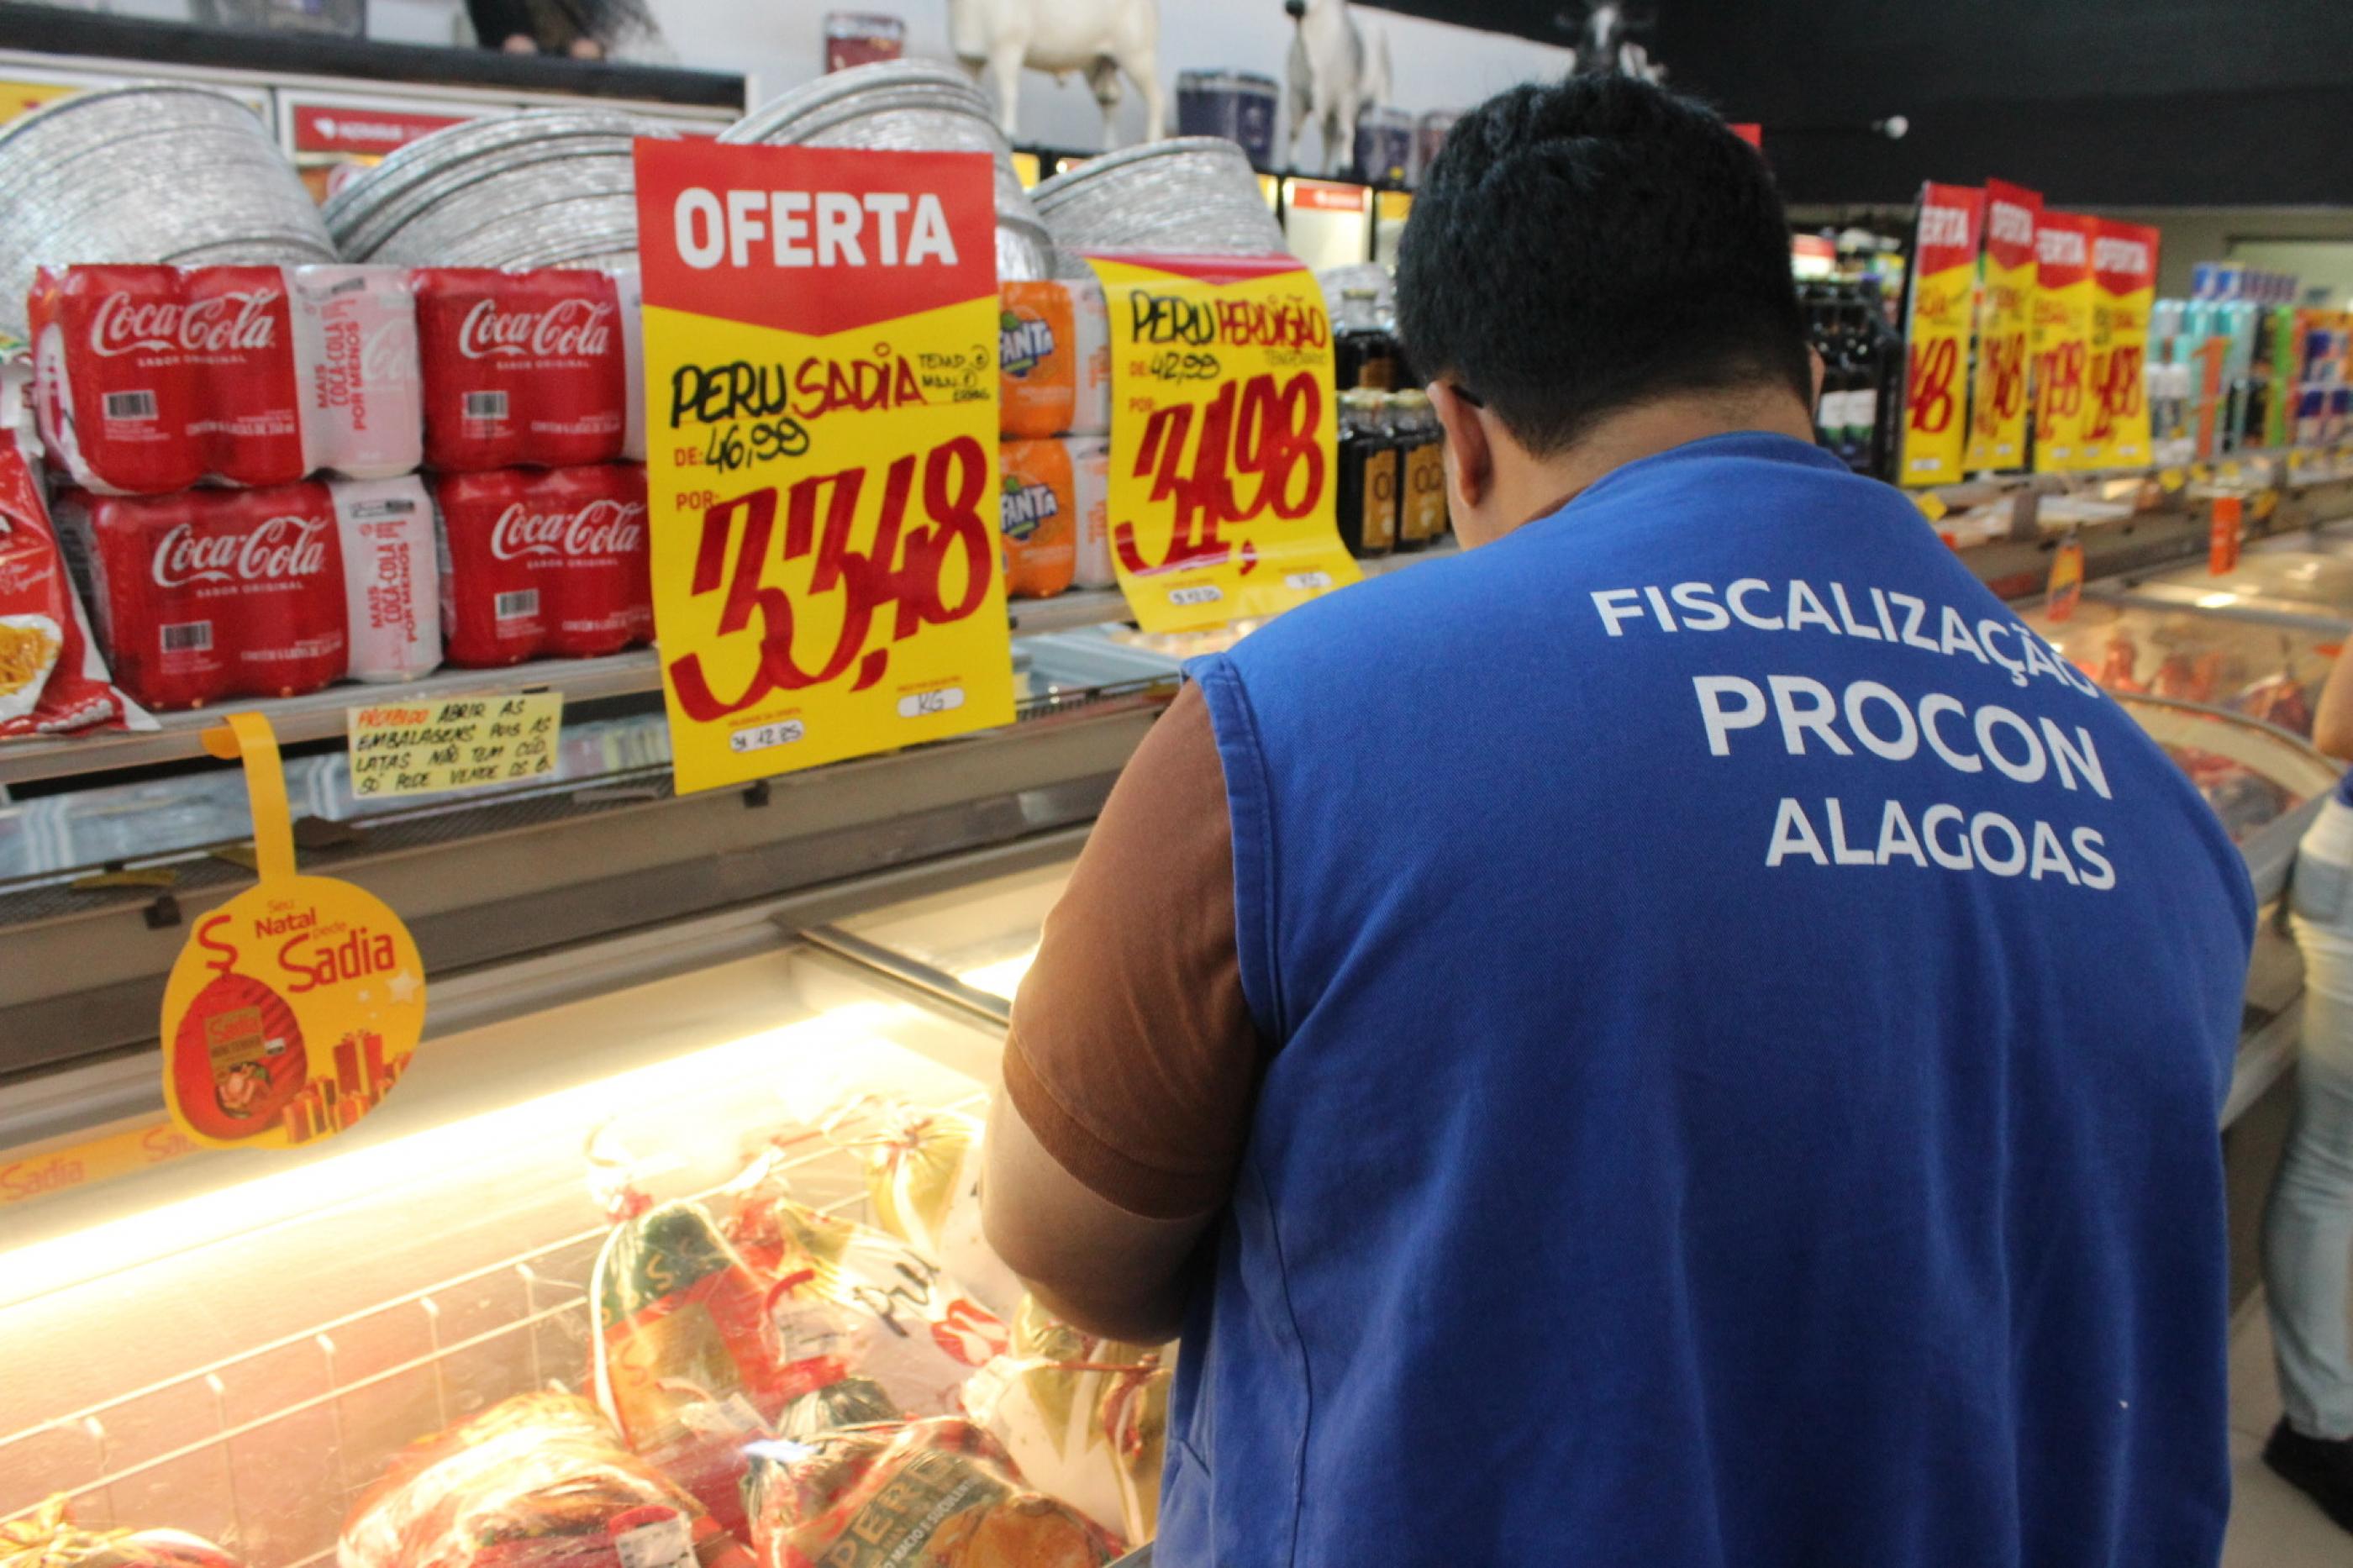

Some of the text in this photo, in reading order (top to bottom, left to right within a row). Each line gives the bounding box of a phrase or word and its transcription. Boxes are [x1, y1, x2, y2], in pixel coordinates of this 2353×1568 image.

[674, 187, 958, 269] OFERTA
[90, 287, 279, 357] Coca-Cola
[459, 298, 613, 359] Coca-Cola
[1131, 291, 1214, 345] PERU
[671, 361, 787, 428] PERU
[706, 417, 810, 474] 46,99
[152, 516, 328, 587] Coca-Cola
[492, 500, 645, 560] Coca-Cola
[437, 701, 486, 723] ABRIR
[500, 699, 525, 716] AS
[1692, 674, 2112, 799] PROCON
[356, 752, 410, 772] LATAS
[1766, 797, 2116, 890] ALAGOAS
[255, 906, 316, 939] Natal
[277, 927, 395, 993] Sadia
